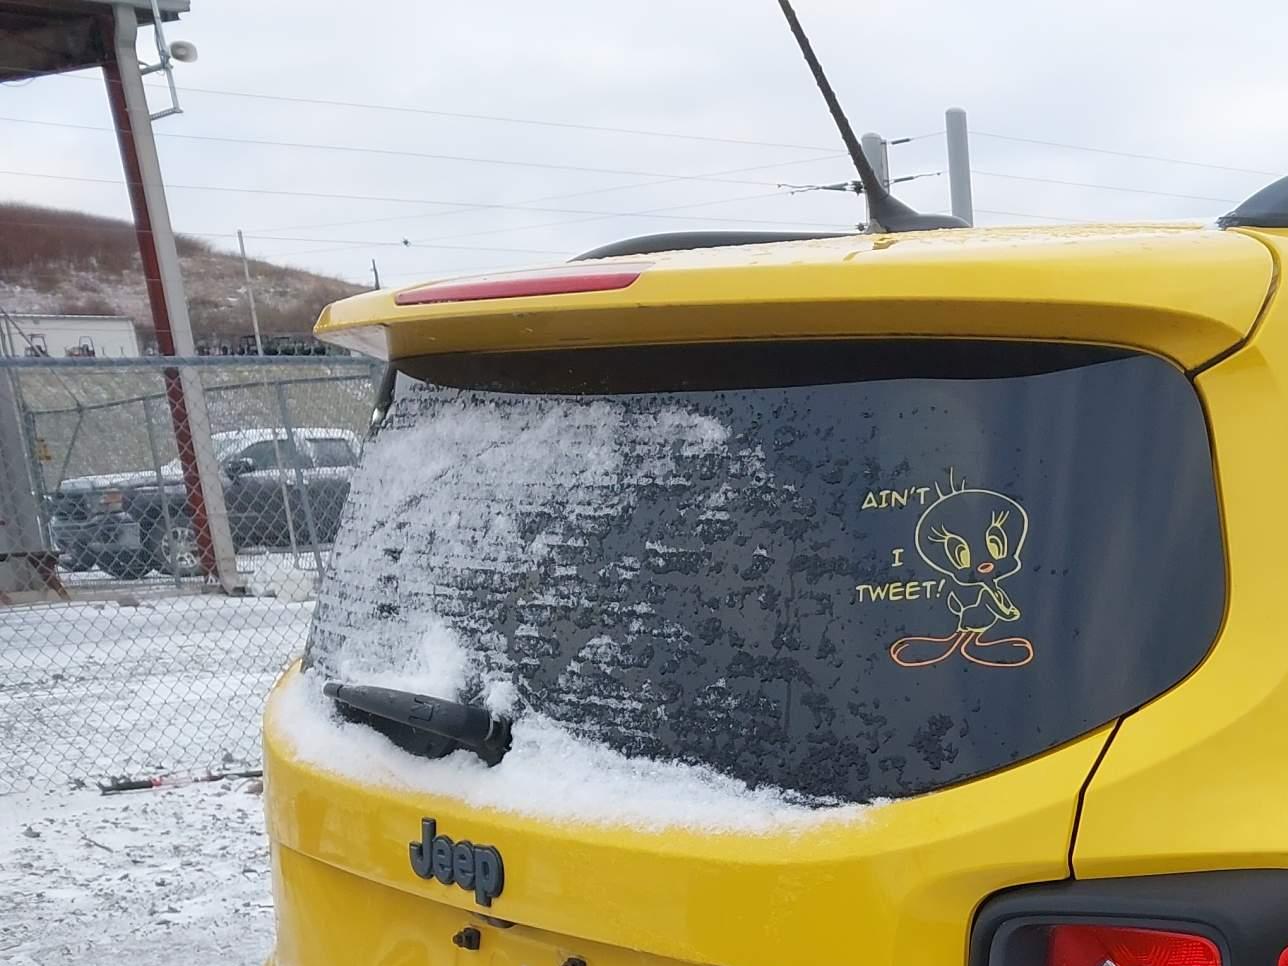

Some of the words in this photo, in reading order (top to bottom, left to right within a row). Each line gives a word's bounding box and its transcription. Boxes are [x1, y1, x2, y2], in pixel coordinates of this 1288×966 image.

[861, 487, 930, 510] AIN'T
[891, 548, 904, 567] I
[855, 578, 945, 602] TWEET!
[408, 816, 505, 908] Jeep
